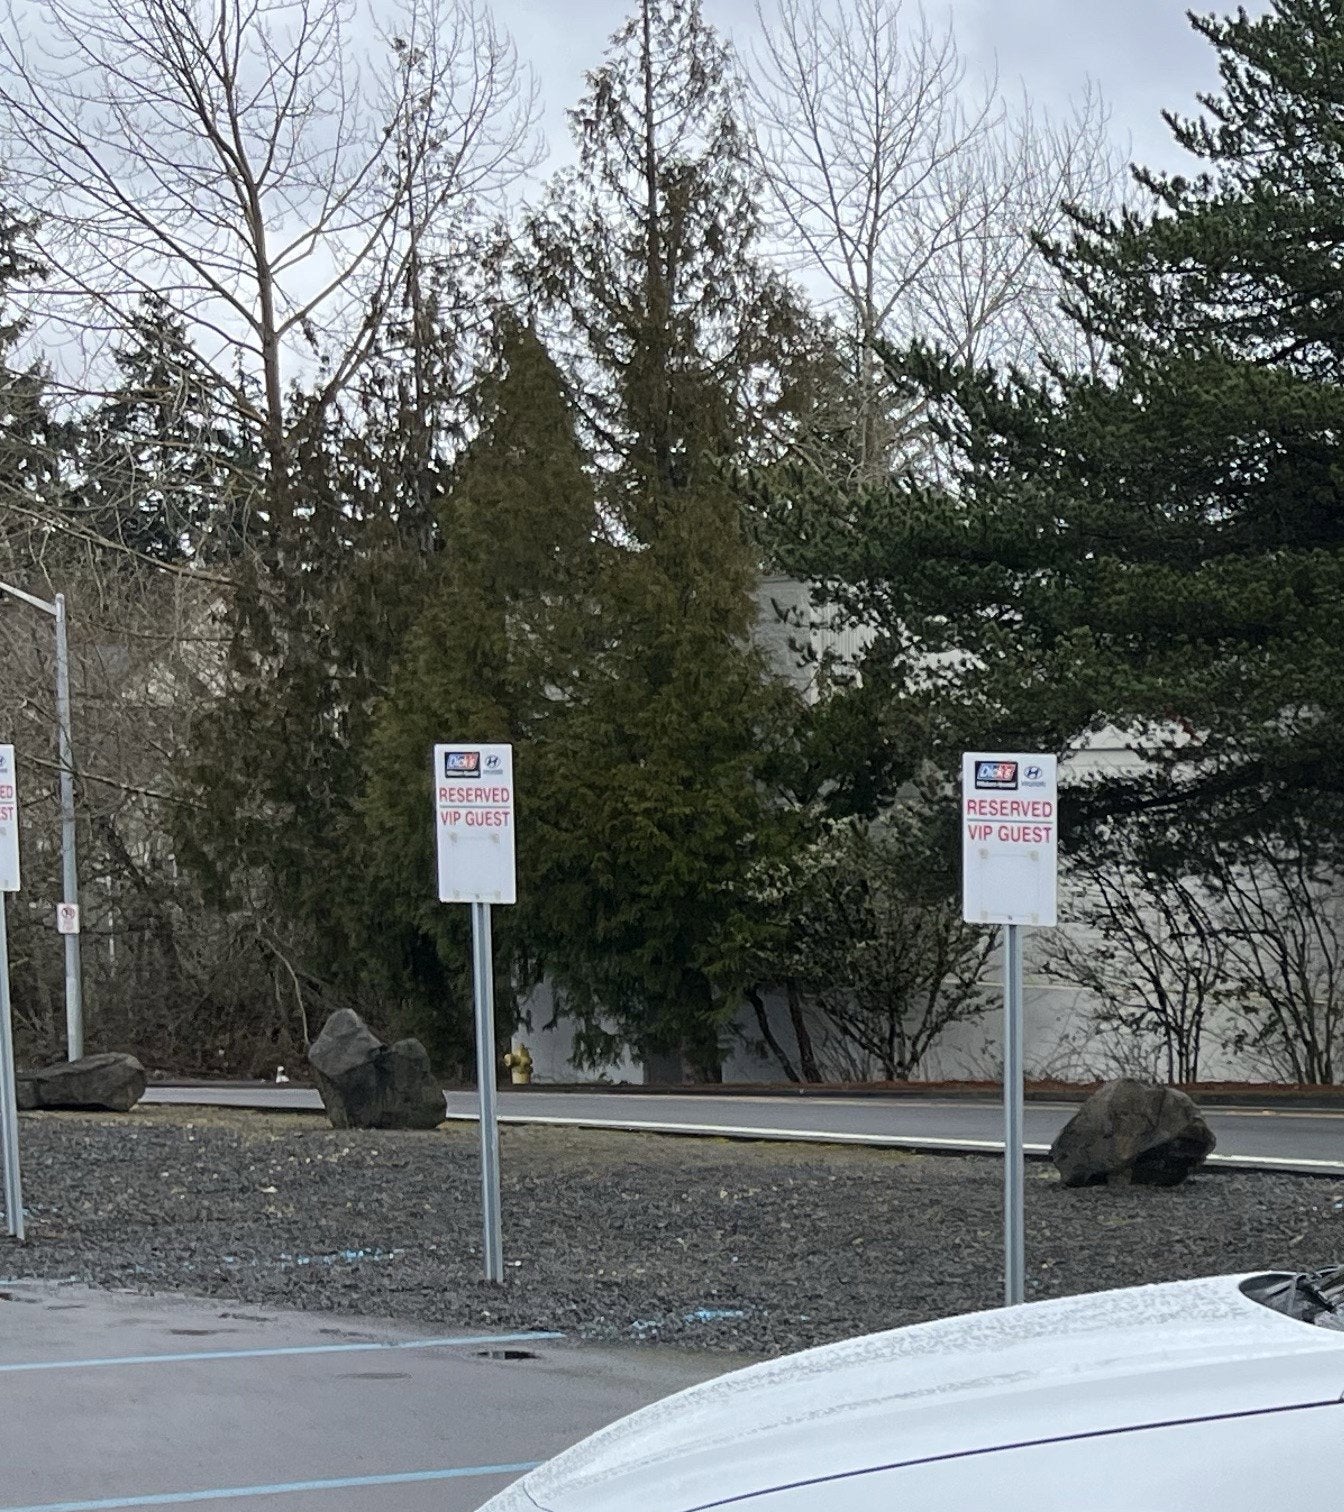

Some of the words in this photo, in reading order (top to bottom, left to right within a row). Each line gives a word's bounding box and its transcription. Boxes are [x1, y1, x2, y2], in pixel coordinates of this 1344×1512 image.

[439, 787, 510, 803] RESERVED
[966, 799, 1053, 818] RESERVED
[440, 811, 461, 826] VIP
[465, 811, 510, 827] GUEST
[968, 824, 993, 841] VIP
[998, 825, 1052, 843] GUEST
